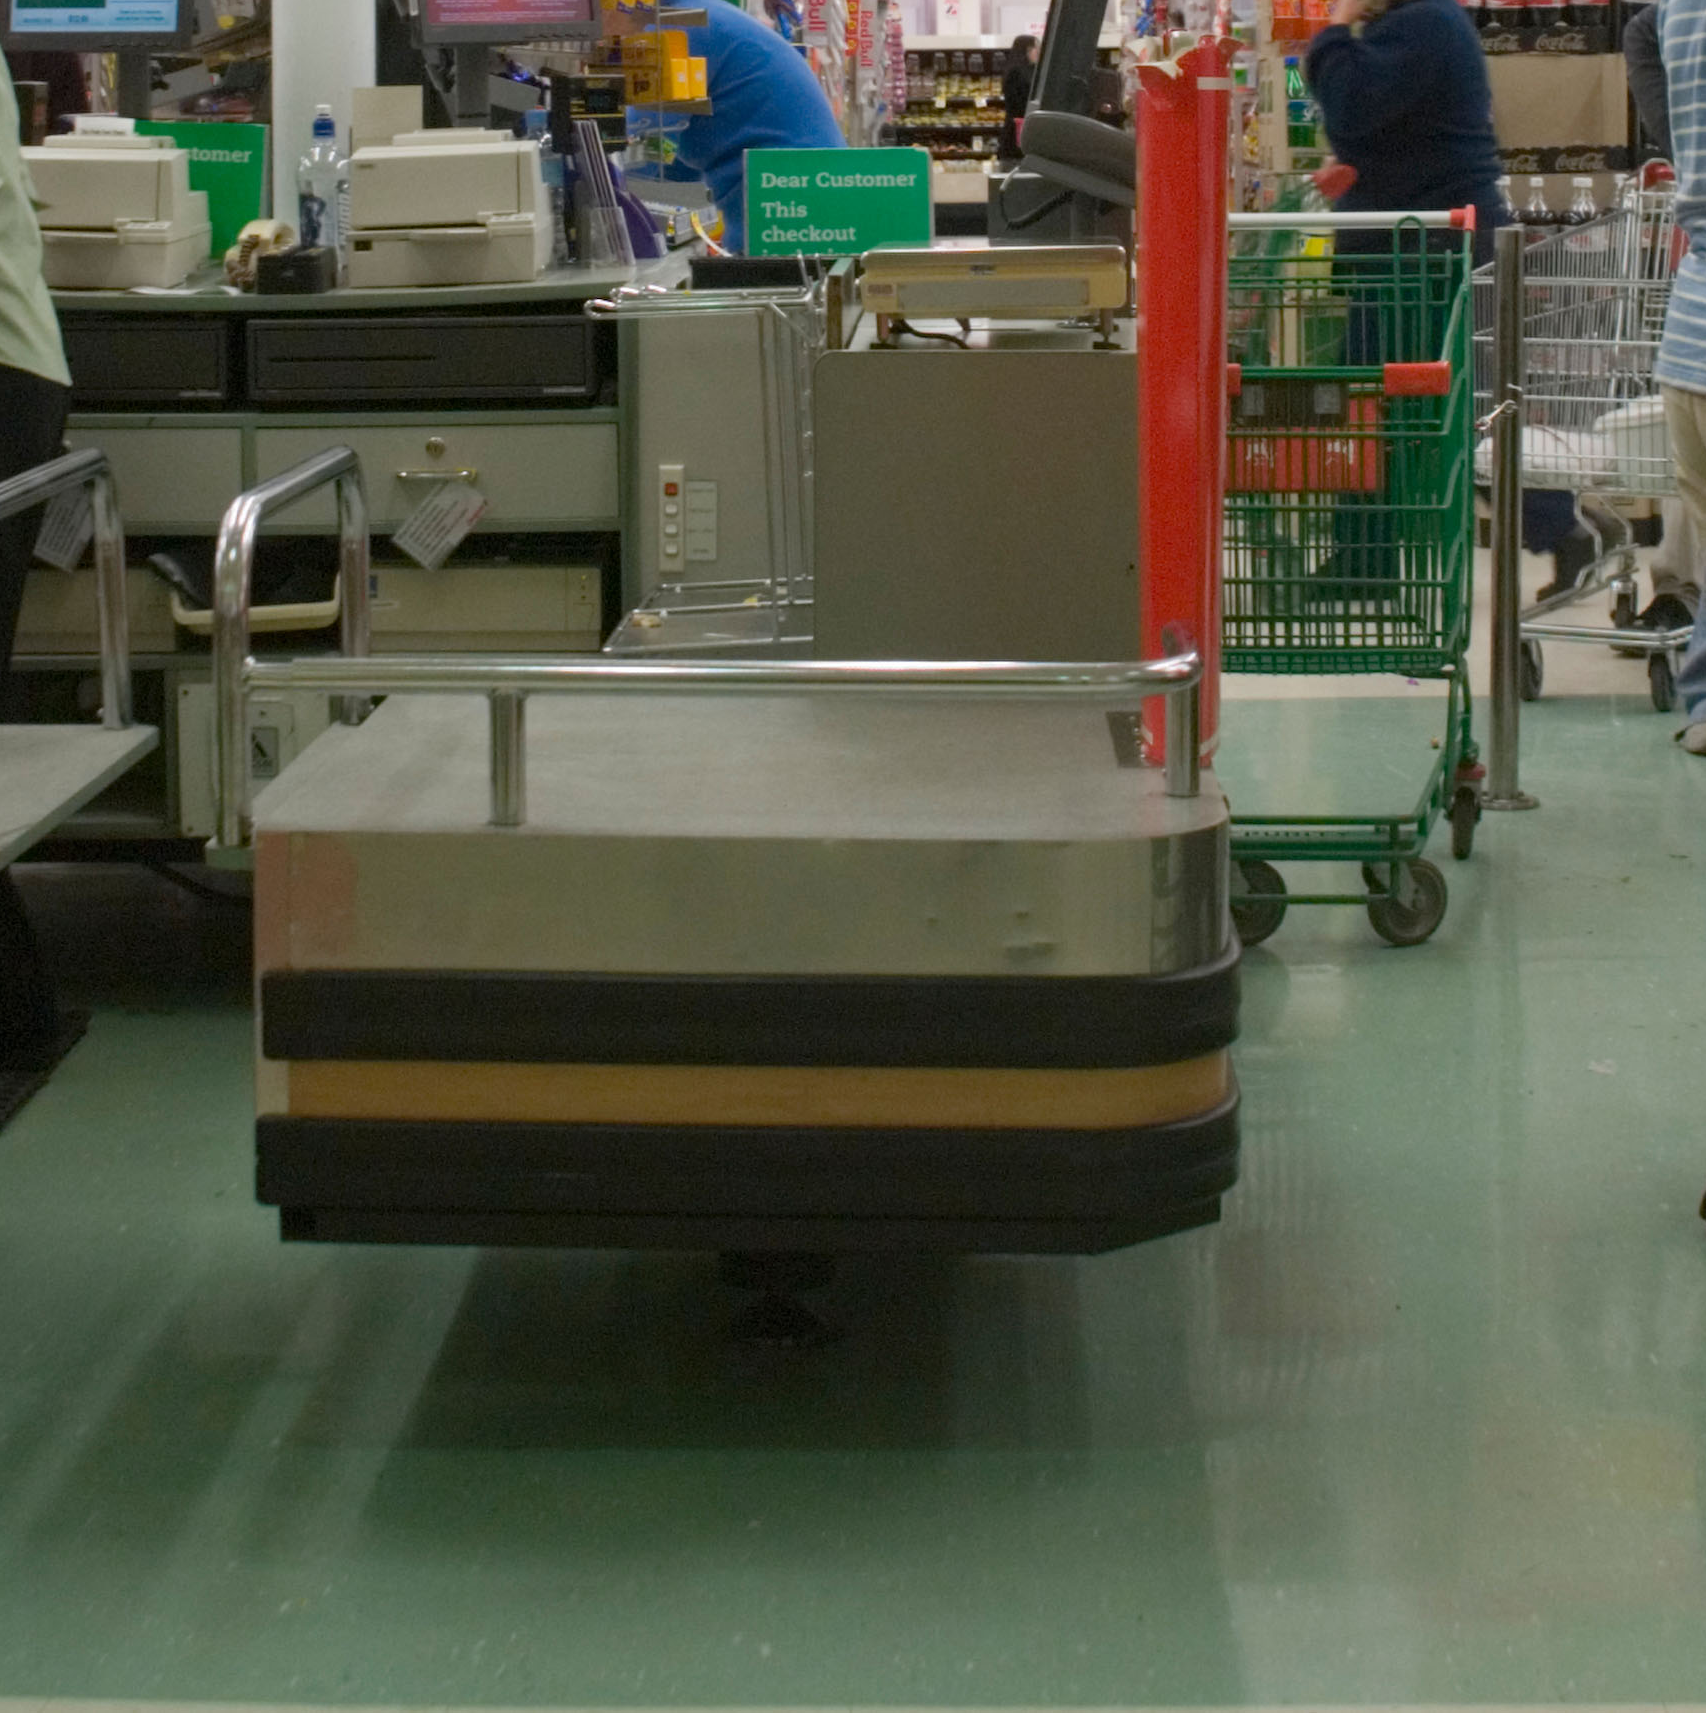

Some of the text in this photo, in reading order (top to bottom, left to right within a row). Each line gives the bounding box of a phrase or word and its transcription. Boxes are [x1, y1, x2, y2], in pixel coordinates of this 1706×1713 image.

[860, 10, 874, 35] Red
[860, 40, 874, 67] Bull
[761, 172, 917, 188] Dear Customer
[761, 201, 807, 218] This
[762, 224, 856, 242] checkout
